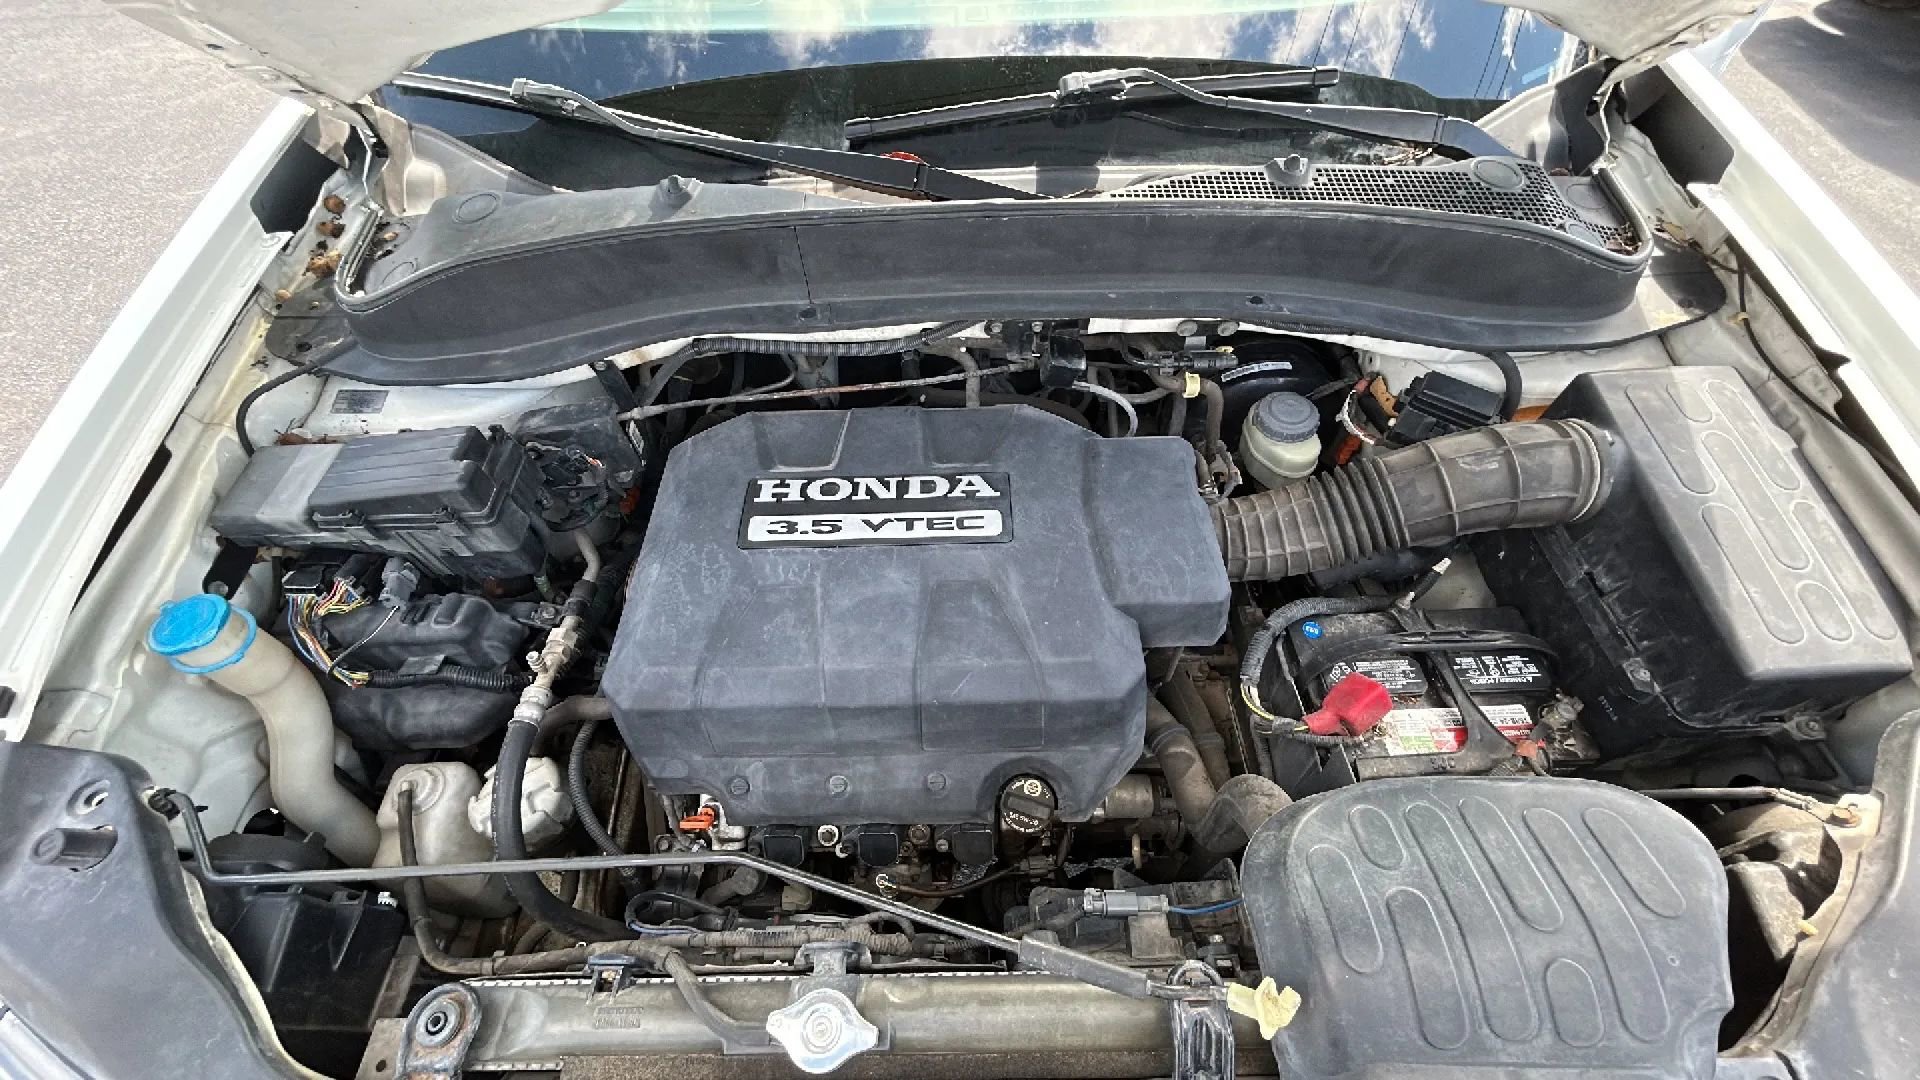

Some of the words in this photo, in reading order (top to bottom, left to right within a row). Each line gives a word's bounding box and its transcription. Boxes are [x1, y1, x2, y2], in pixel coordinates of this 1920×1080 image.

[753, 475, 1001, 503] HONDA
[766, 519, 843, 535] 3.5
[861, 515, 985, 532] VTEC
